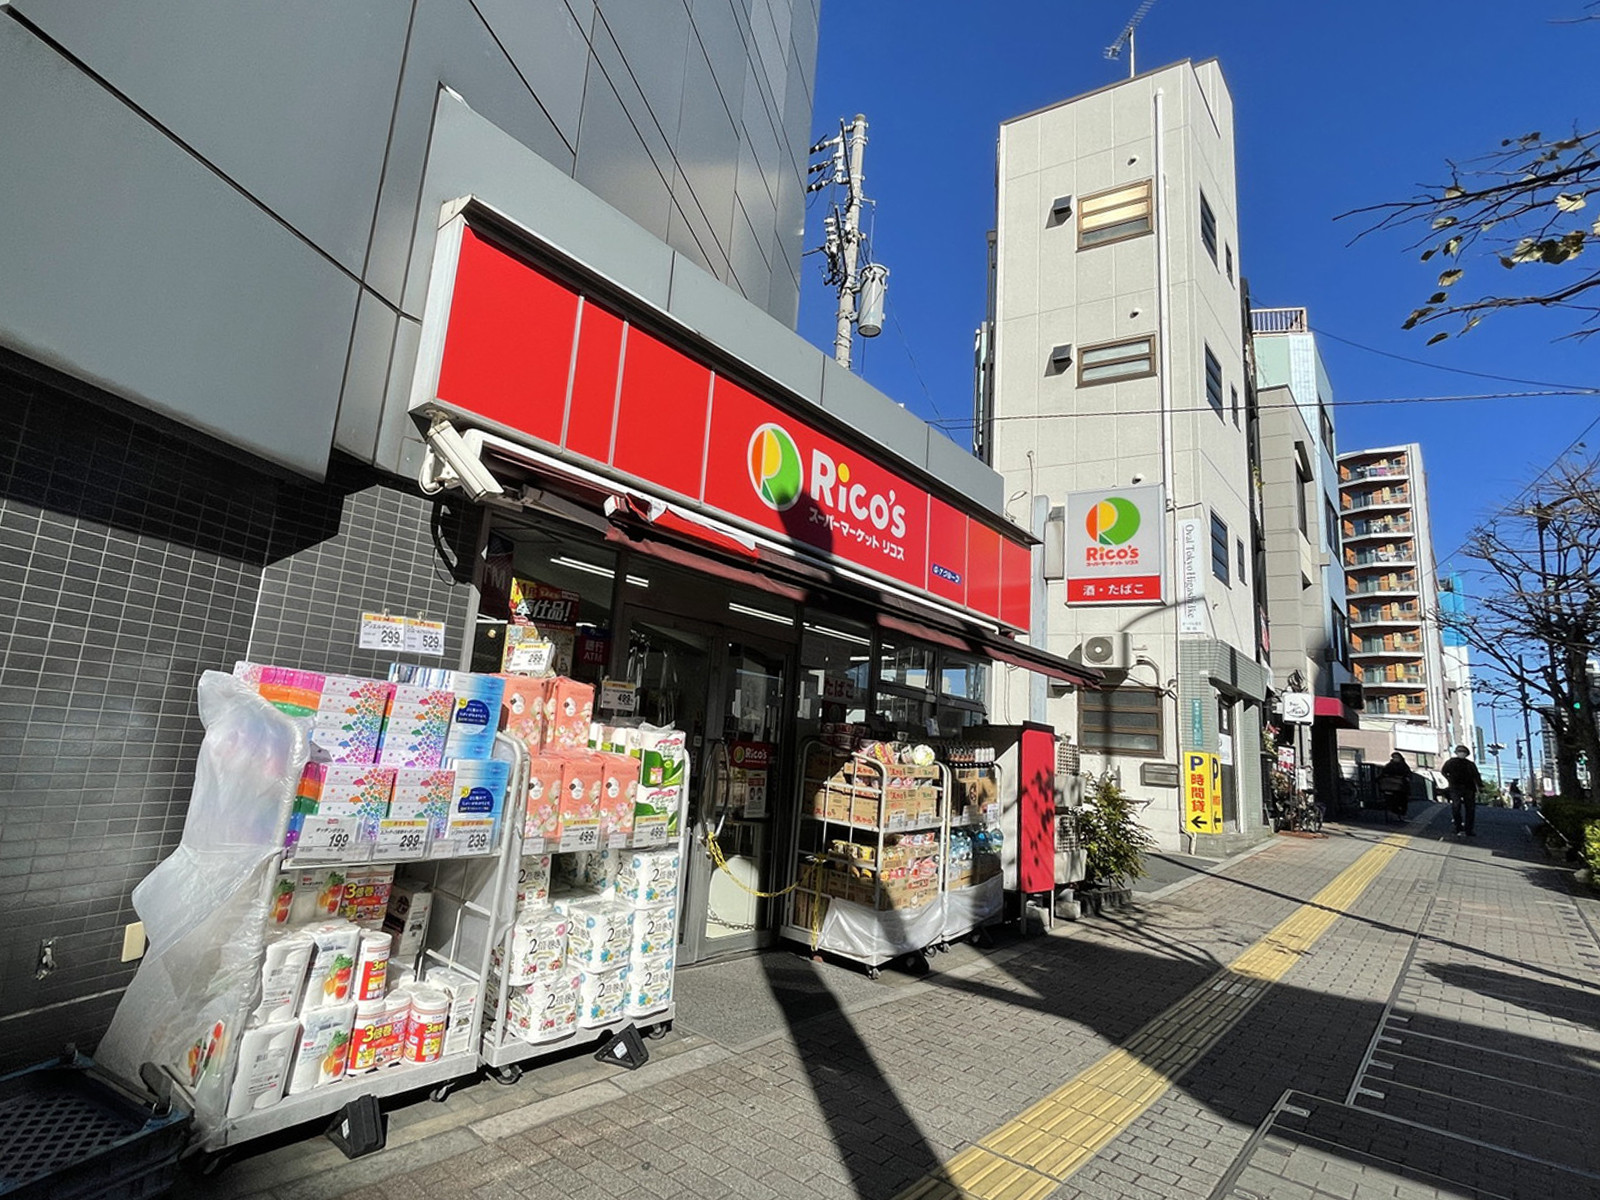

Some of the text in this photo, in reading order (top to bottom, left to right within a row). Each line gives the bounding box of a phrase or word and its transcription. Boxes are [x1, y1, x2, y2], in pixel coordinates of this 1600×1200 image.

[811, 448, 906, 539] Rico's
[809, 506, 906, 561] スーパーマーケット リコス
[1185, 524, 1195, 544] Oval
[1086, 544, 1140, 562] Rico's
[1184, 545, 1196, 570] Tokyo
[1082, 583, 1145, 597] 酒・たばこ
[381, 630, 401, 644] 299
[423, 635, 440, 649] 529
[528, 653, 543, 663] 299
[583, 652, 603, 664] ATM
[825, 677, 854, 699] たばこ
[744, 745, 768, 760] Rico's
[1190, 755, 1204, 772] P
[1212, 757, 1219, 790] P
[1190, 773, 1206, 814] 時間貸
[328, 833, 349, 848] 199
[399, 834, 420, 848] 299
[467, 833, 487, 848] 239
[579, 830, 594, 842] 499
